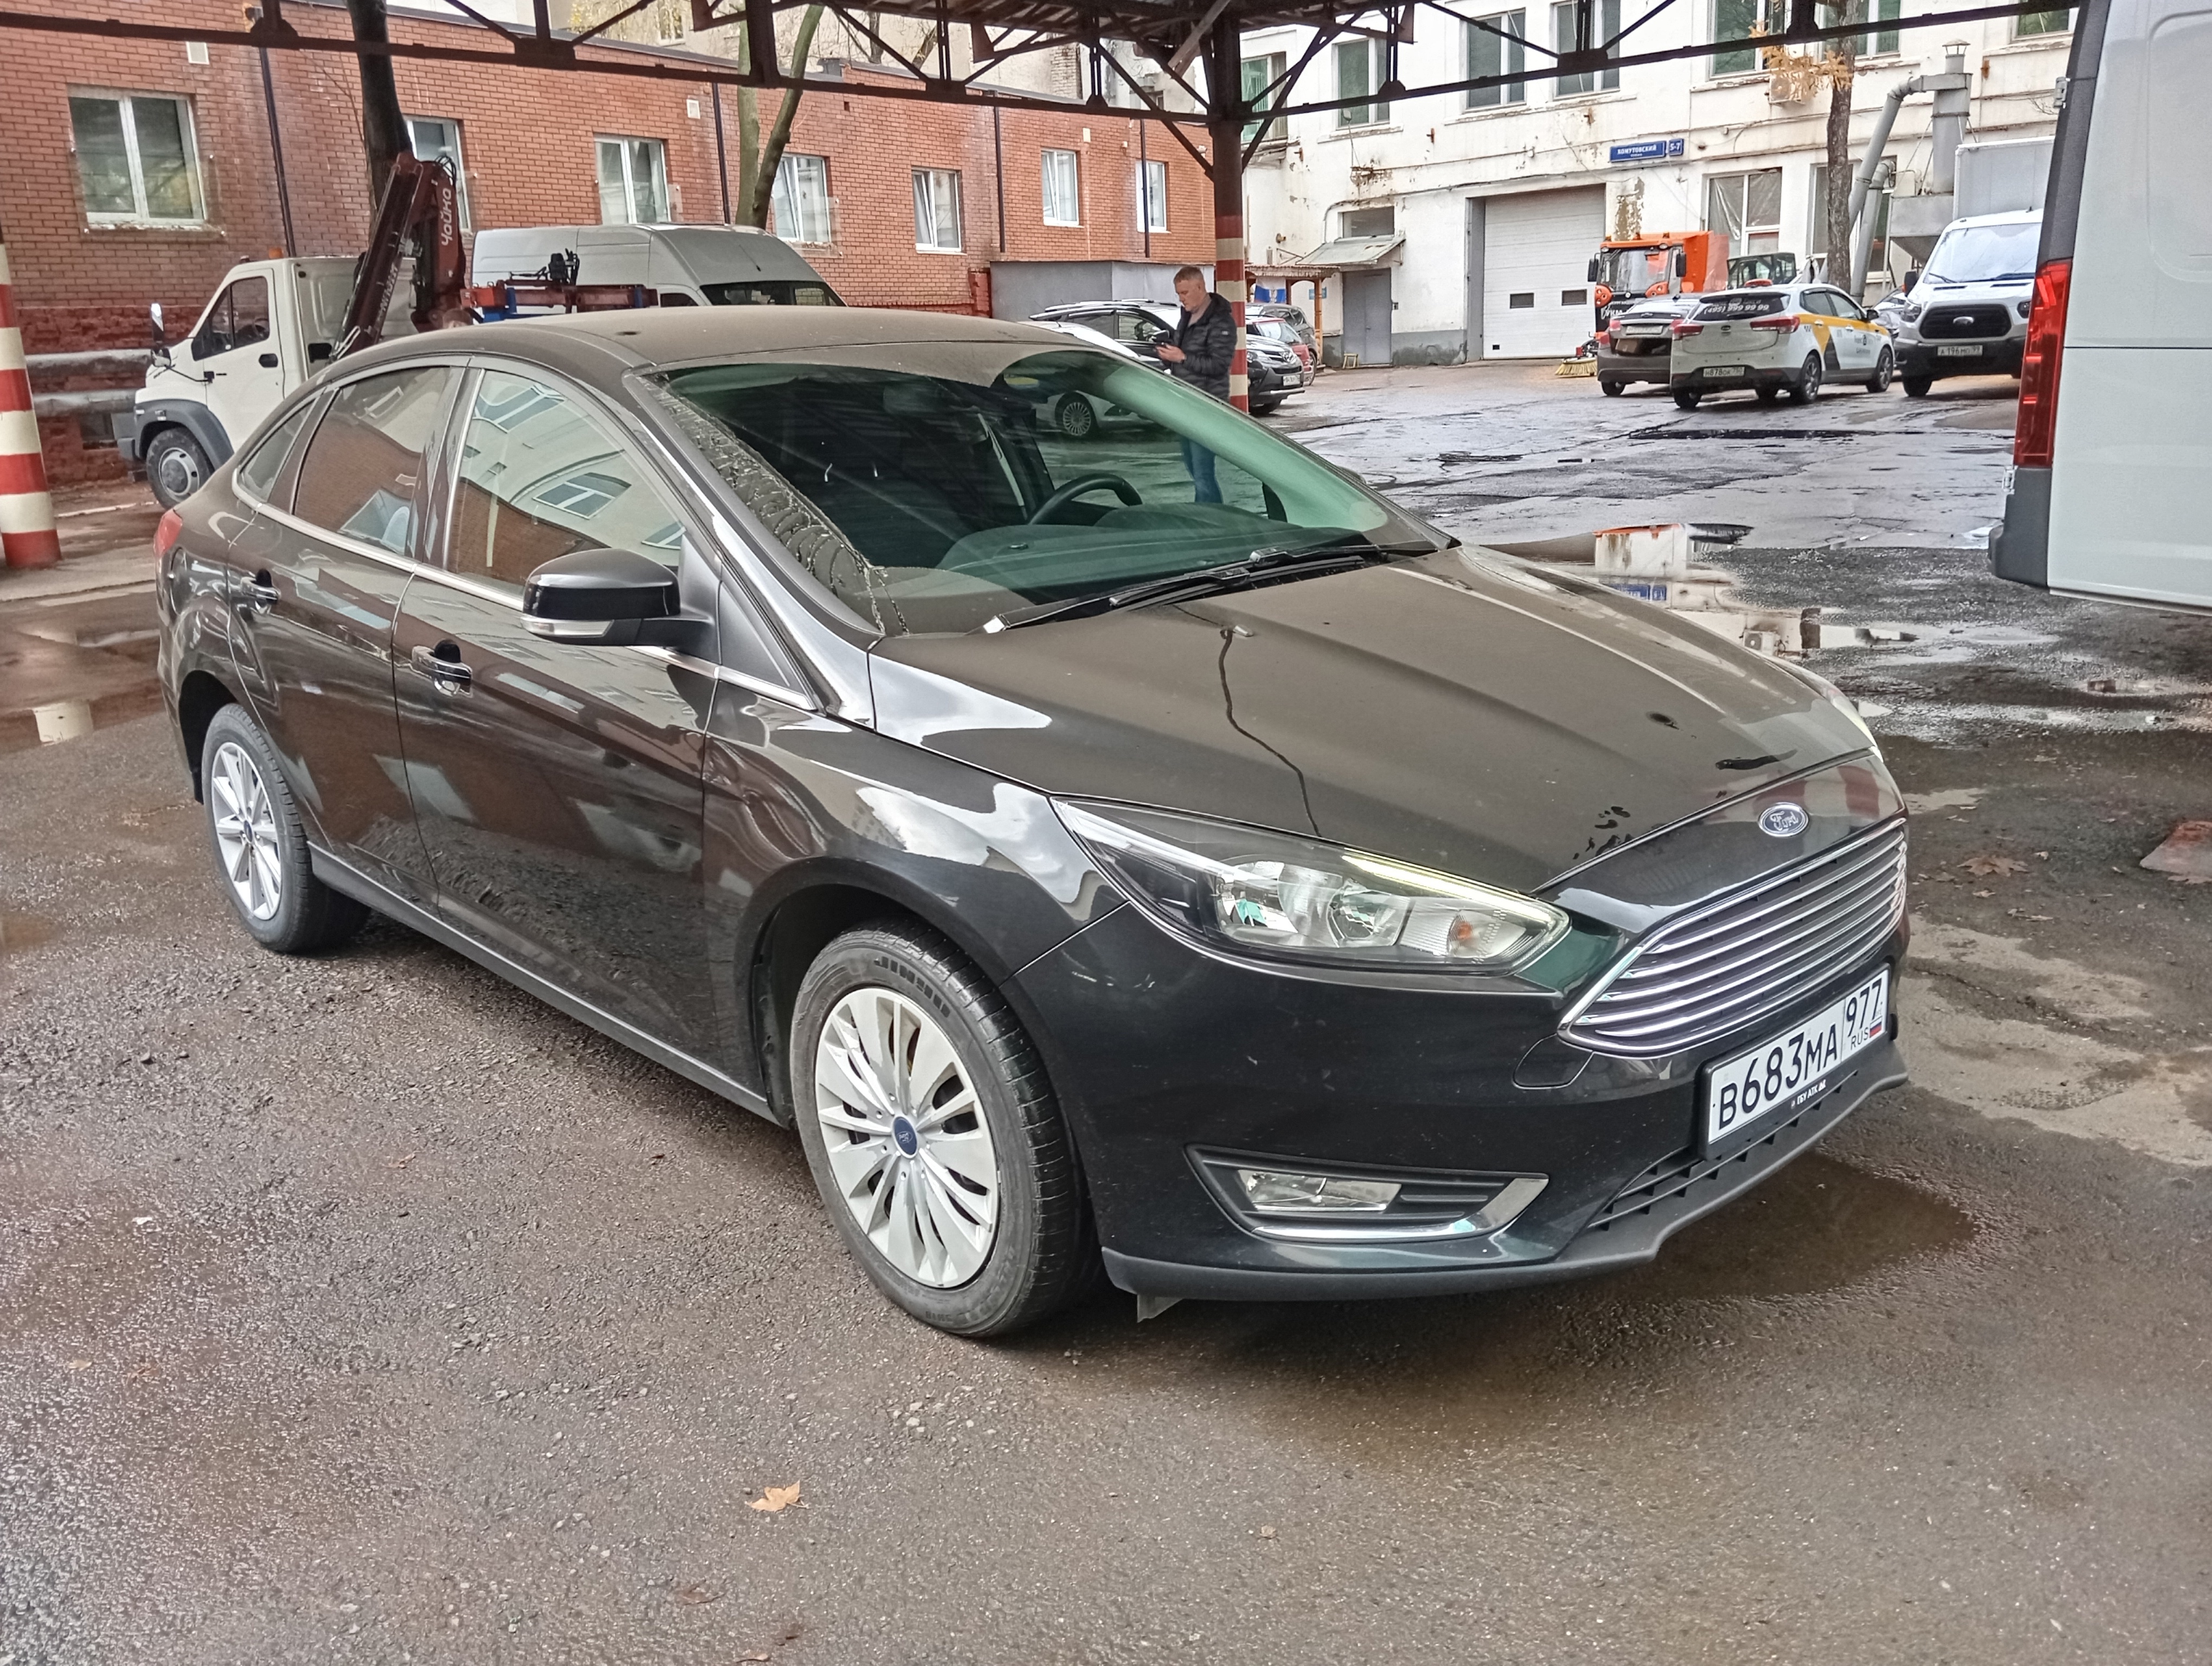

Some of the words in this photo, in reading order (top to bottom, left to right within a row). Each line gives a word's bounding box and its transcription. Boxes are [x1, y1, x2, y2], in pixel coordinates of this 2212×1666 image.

[1670, 142, 1681, 151] 5-7
[441, 188, 452, 246] Чайка
[1704, 306, 1725, 314] (495)
[1770, 810, 1799, 831] Ford
[1850, 1027, 1869, 1050] RUS
[1719, 1023, 1837, 1131] В683МА
[1846, 977, 1882, 1037] 977
[1797, 1091, 1807, 1105] ГБУ
[1807, 1085, 1818, 1099] АТК
